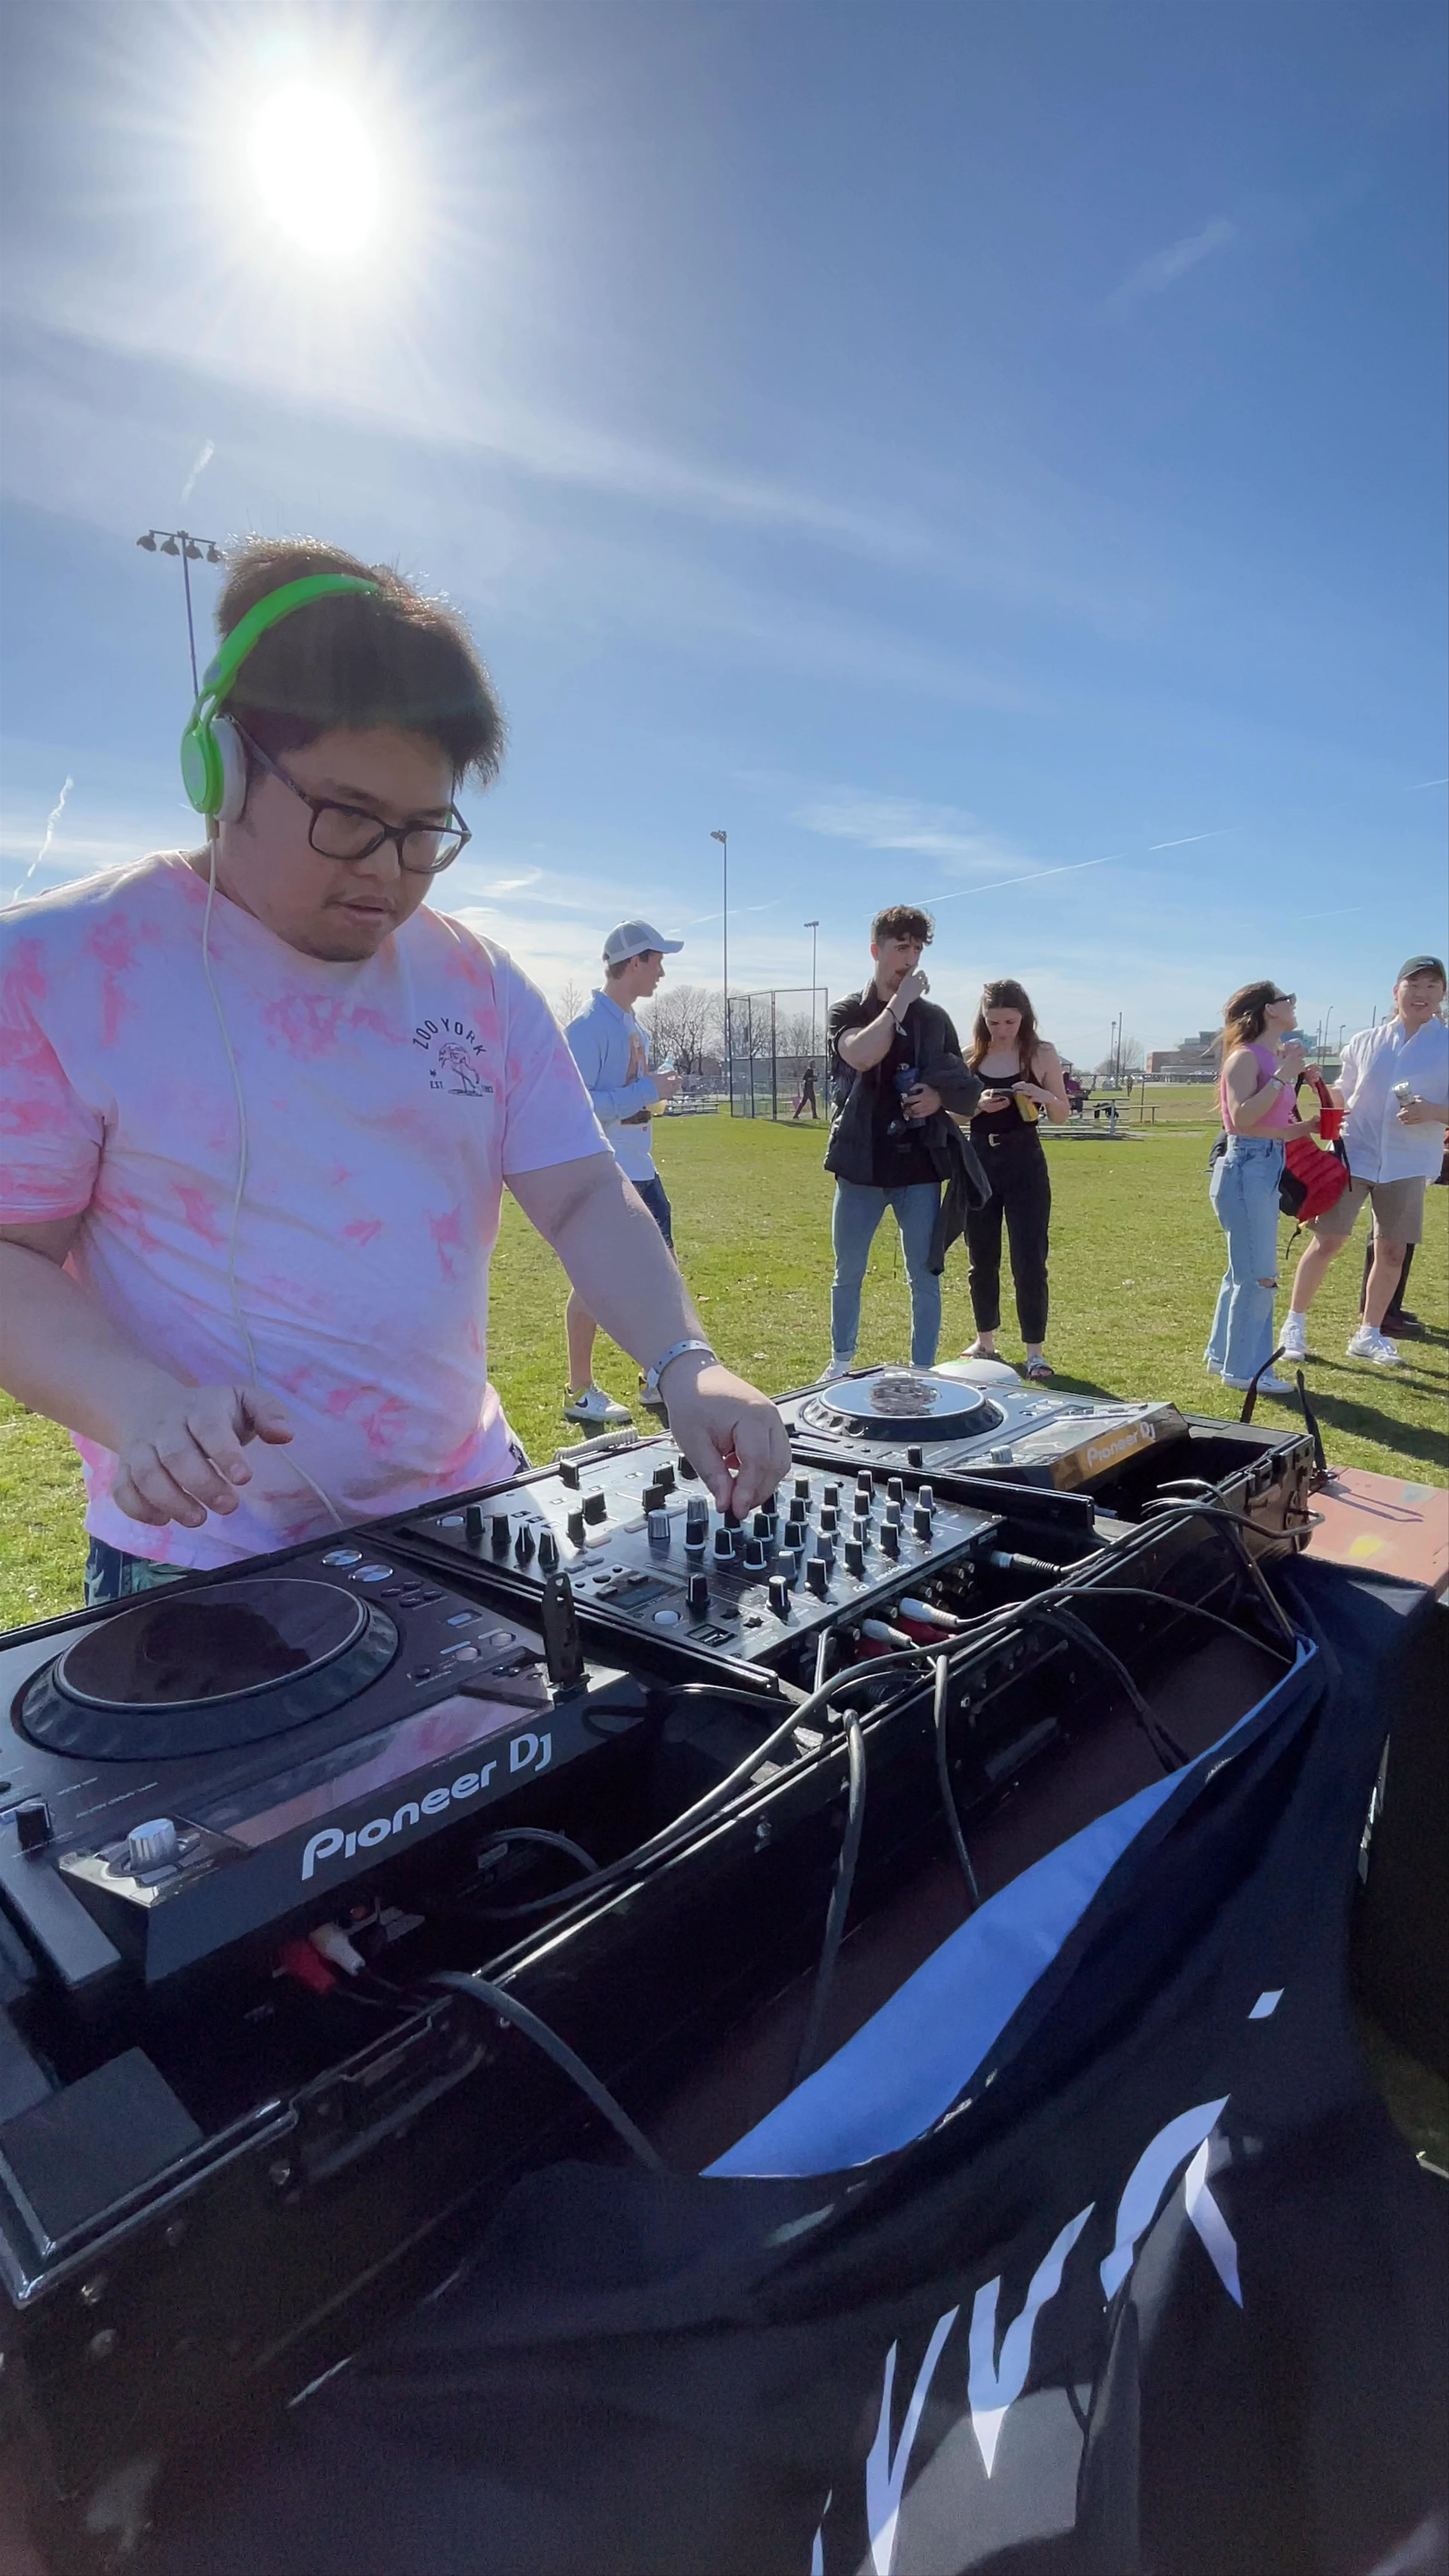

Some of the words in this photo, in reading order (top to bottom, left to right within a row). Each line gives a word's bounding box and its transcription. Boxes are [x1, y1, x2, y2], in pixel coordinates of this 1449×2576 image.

[413, 1020, 438, 1049] ZOO
[441, 1017, 487, 1055] YORK
[1087, 1430, 1138, 1467] Pioneer
[1140, 1422, 1156, 1442] DJ
[302, 1760, 497, 1880] Pioneer
[510, 1733, 552, 1772] DJ
